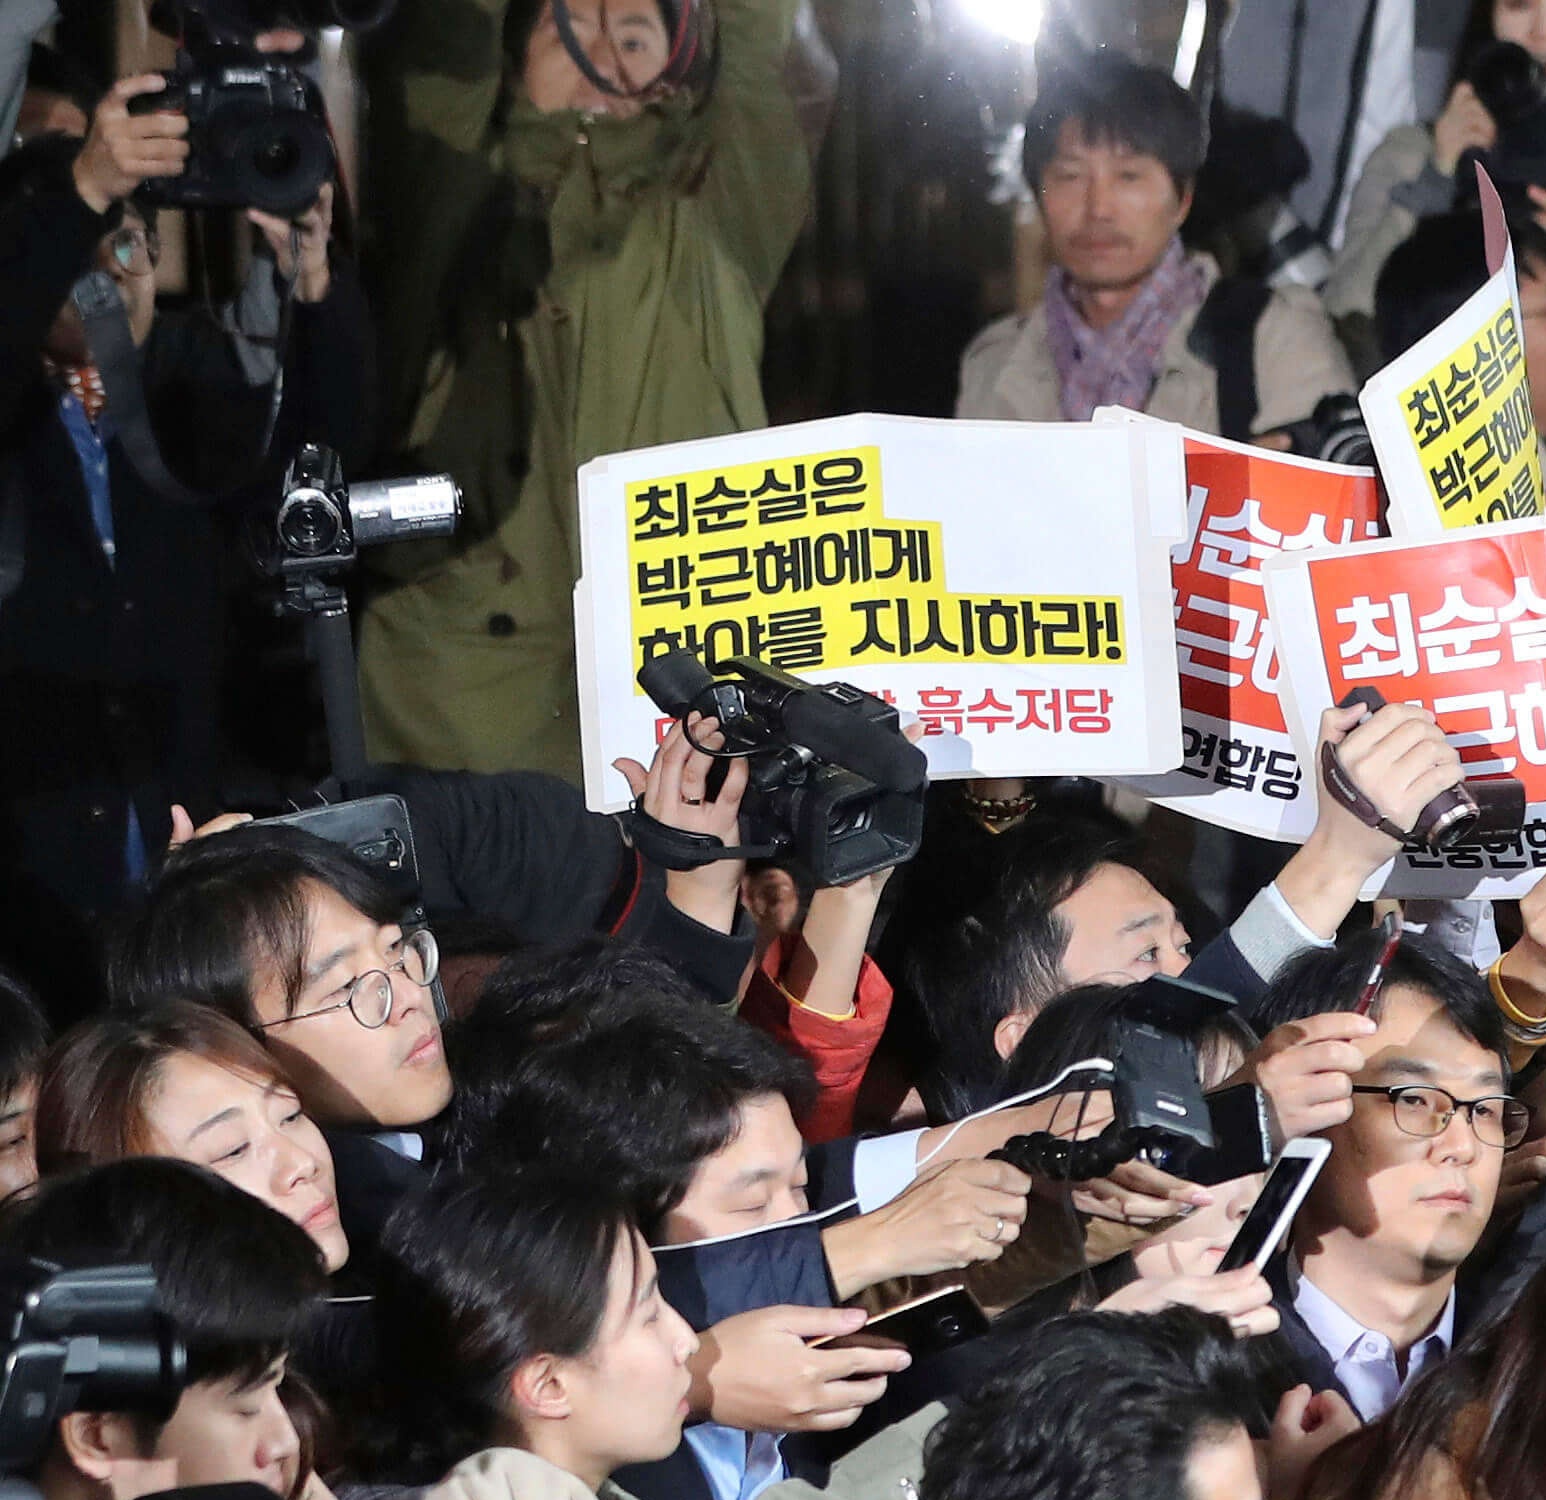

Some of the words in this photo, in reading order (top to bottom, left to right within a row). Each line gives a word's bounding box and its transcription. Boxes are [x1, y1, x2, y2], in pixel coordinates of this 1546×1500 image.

[1407, 307, 1522, 449] 최순실은
[633, 456, 867, 542] 최순실은
[1463, 461, 1538, 526] 야를
[637, 526, 933, 610] 박근혜에게
[849, 598, 1123, 661] 지시하라!
[917, 687, 1114, 736] 흙수저당
